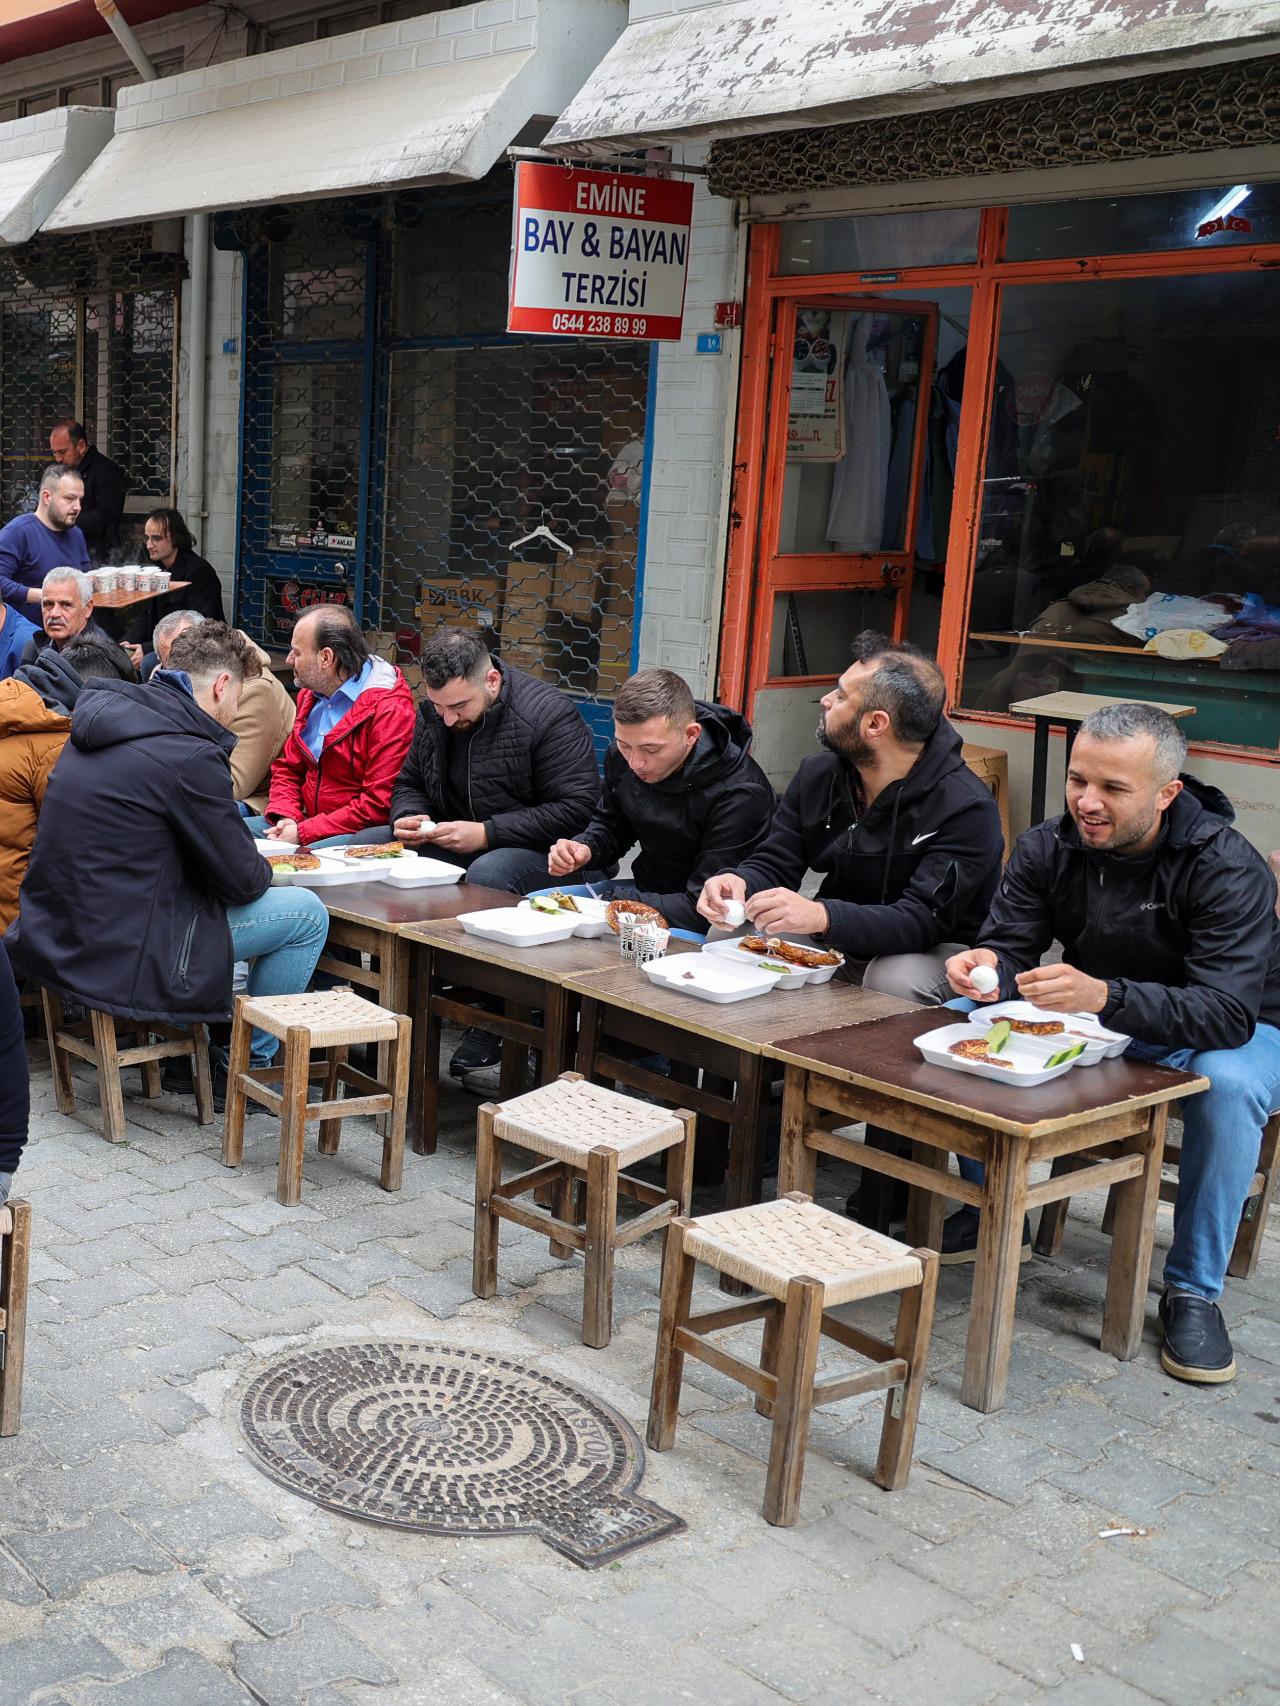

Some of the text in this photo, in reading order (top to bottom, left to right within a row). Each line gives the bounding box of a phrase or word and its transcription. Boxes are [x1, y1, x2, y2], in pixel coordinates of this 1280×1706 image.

[576, 177, 646, 216] EMİNE
[524, 217, 686, 266] BAY & BAYAN
[562, 268, 648, 308] TERZİSİ
[552, 313, 647, 335] 0544 238 89 99
